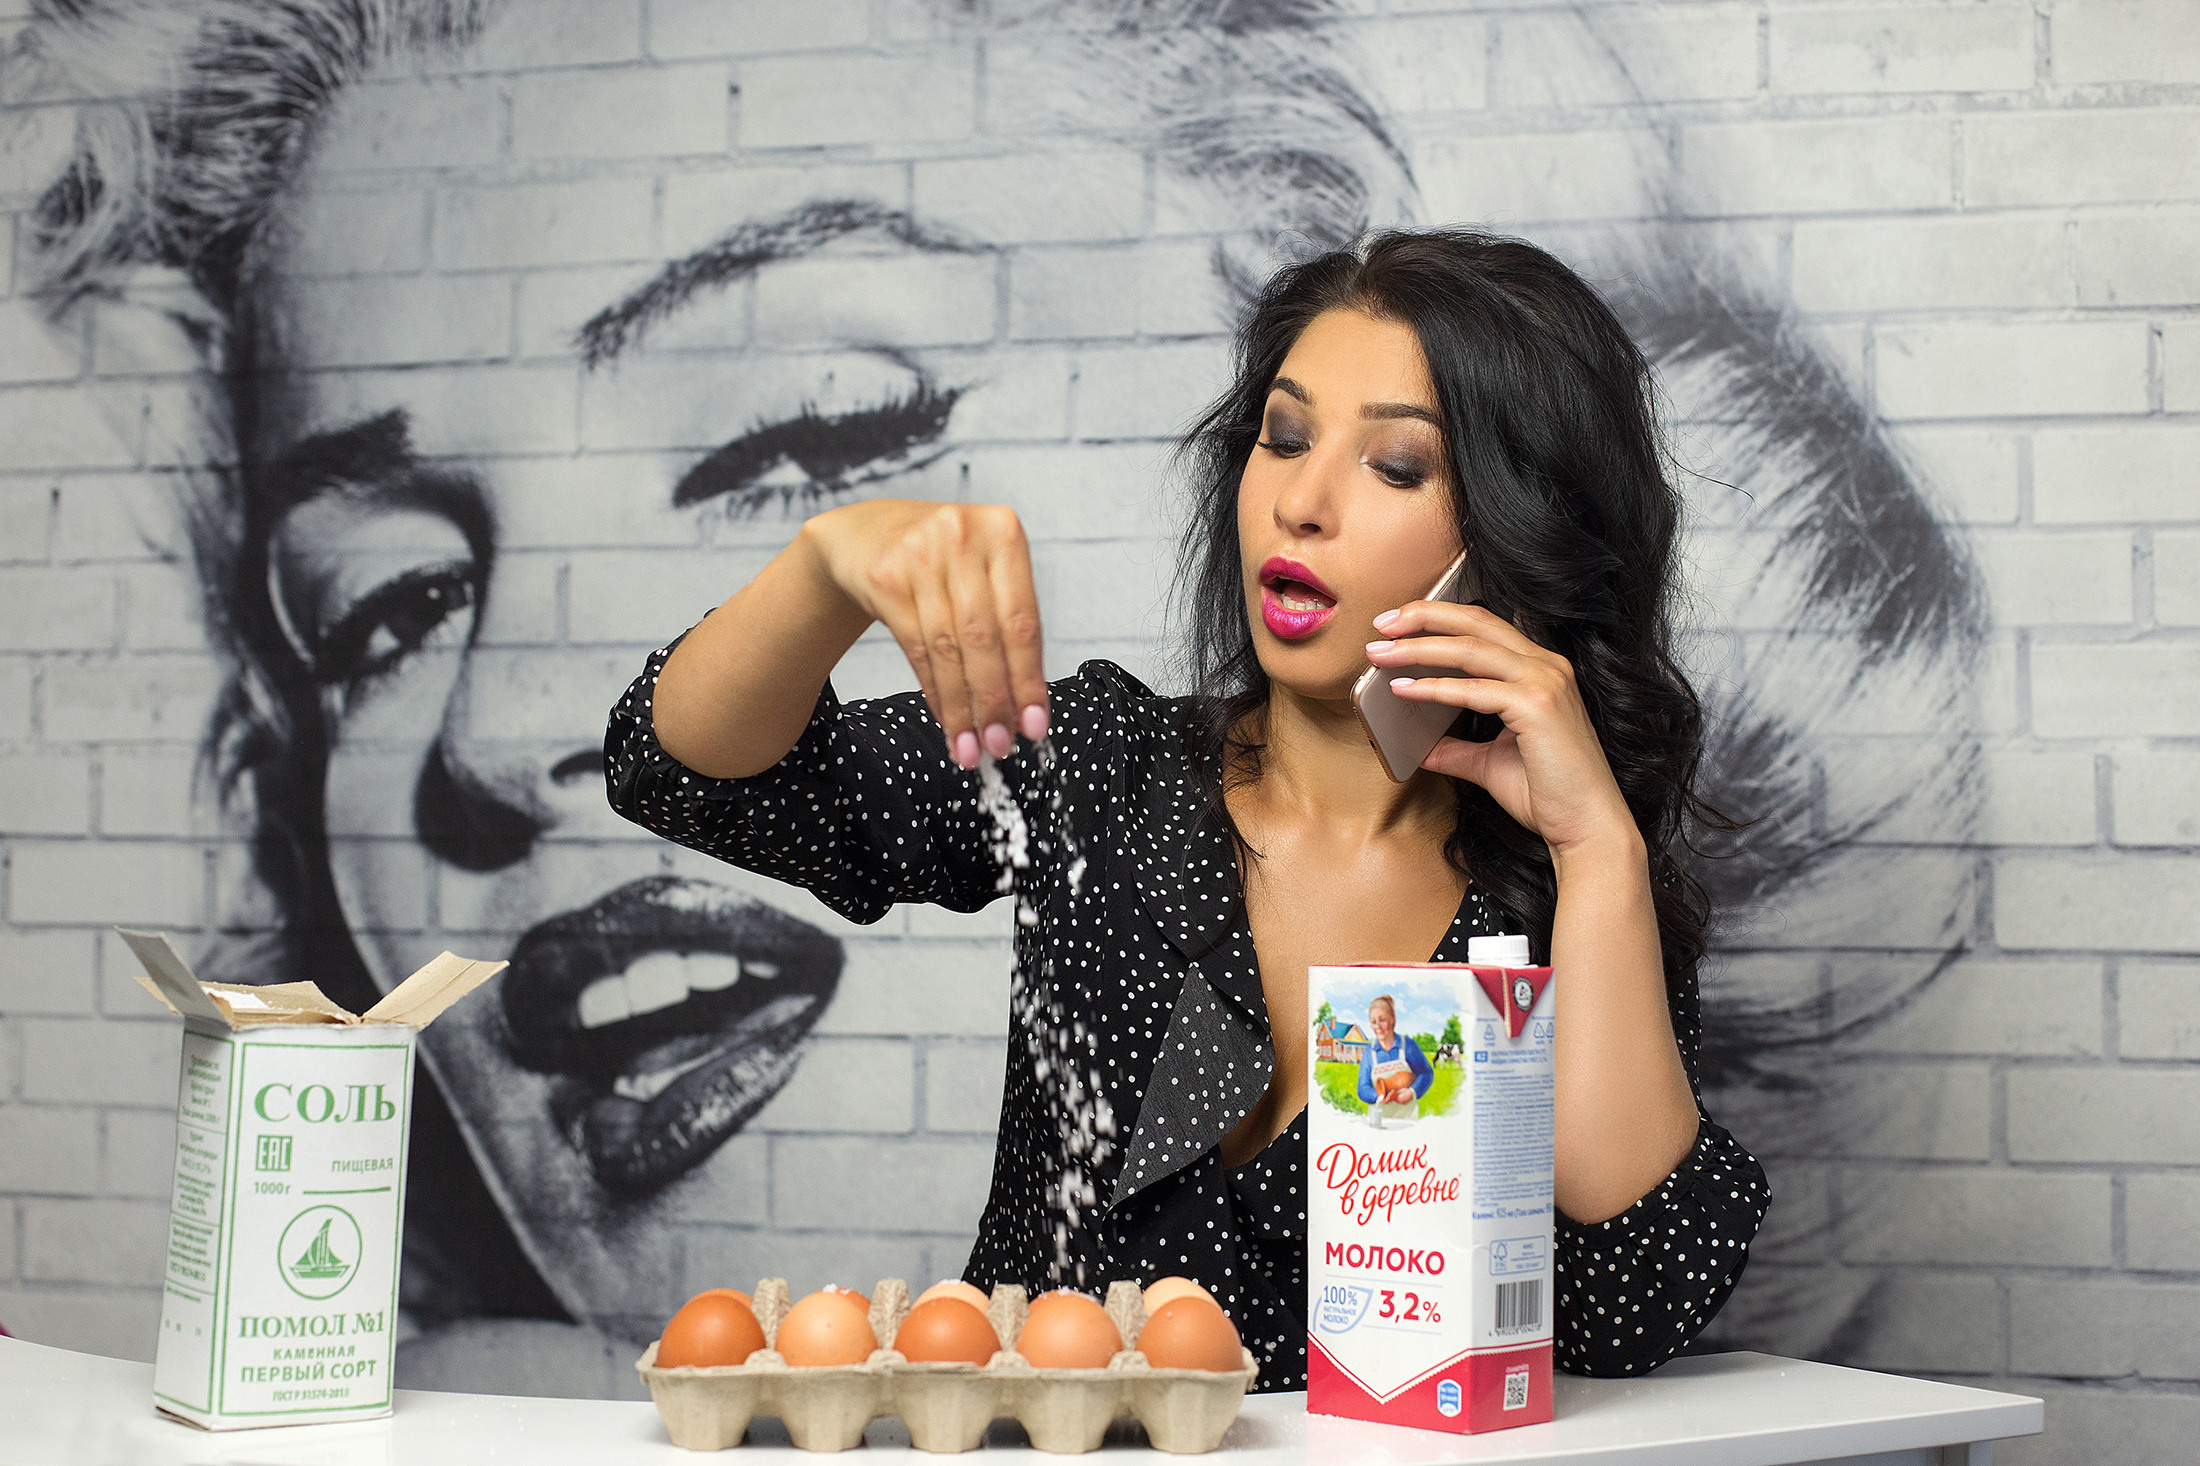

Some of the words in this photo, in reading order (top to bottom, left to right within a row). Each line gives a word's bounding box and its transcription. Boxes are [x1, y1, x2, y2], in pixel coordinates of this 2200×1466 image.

[254, 1083, 395, 1123] СОЛЬ
[331, 1158, 393, 1174] ПИЩЕВАЯ
[1316, 1143, 1428, 1189] Домик
[1339, 1179, 1359, 1215] в
[1357, 1167, 1460, 1226] деревне
[1325, 1241, 1445, 1275] МОЛОКО
[1323, 1285, 1358, 1306] 100%
[1378, 1289, 1441, 1323] 3,2%
[238, 1314, 346, 1338] ПОМОЛ
[351, 1310, 384, 1334] №1
[1323, 1313, 1349, 1325] МОЛОКО
[273, 1345, 355, 1360] КАМЕННАЯ
[241, 1361, 324, 1383] ПЕРВЫЙ
[330, 1360, 377, 1379] СОРТ
